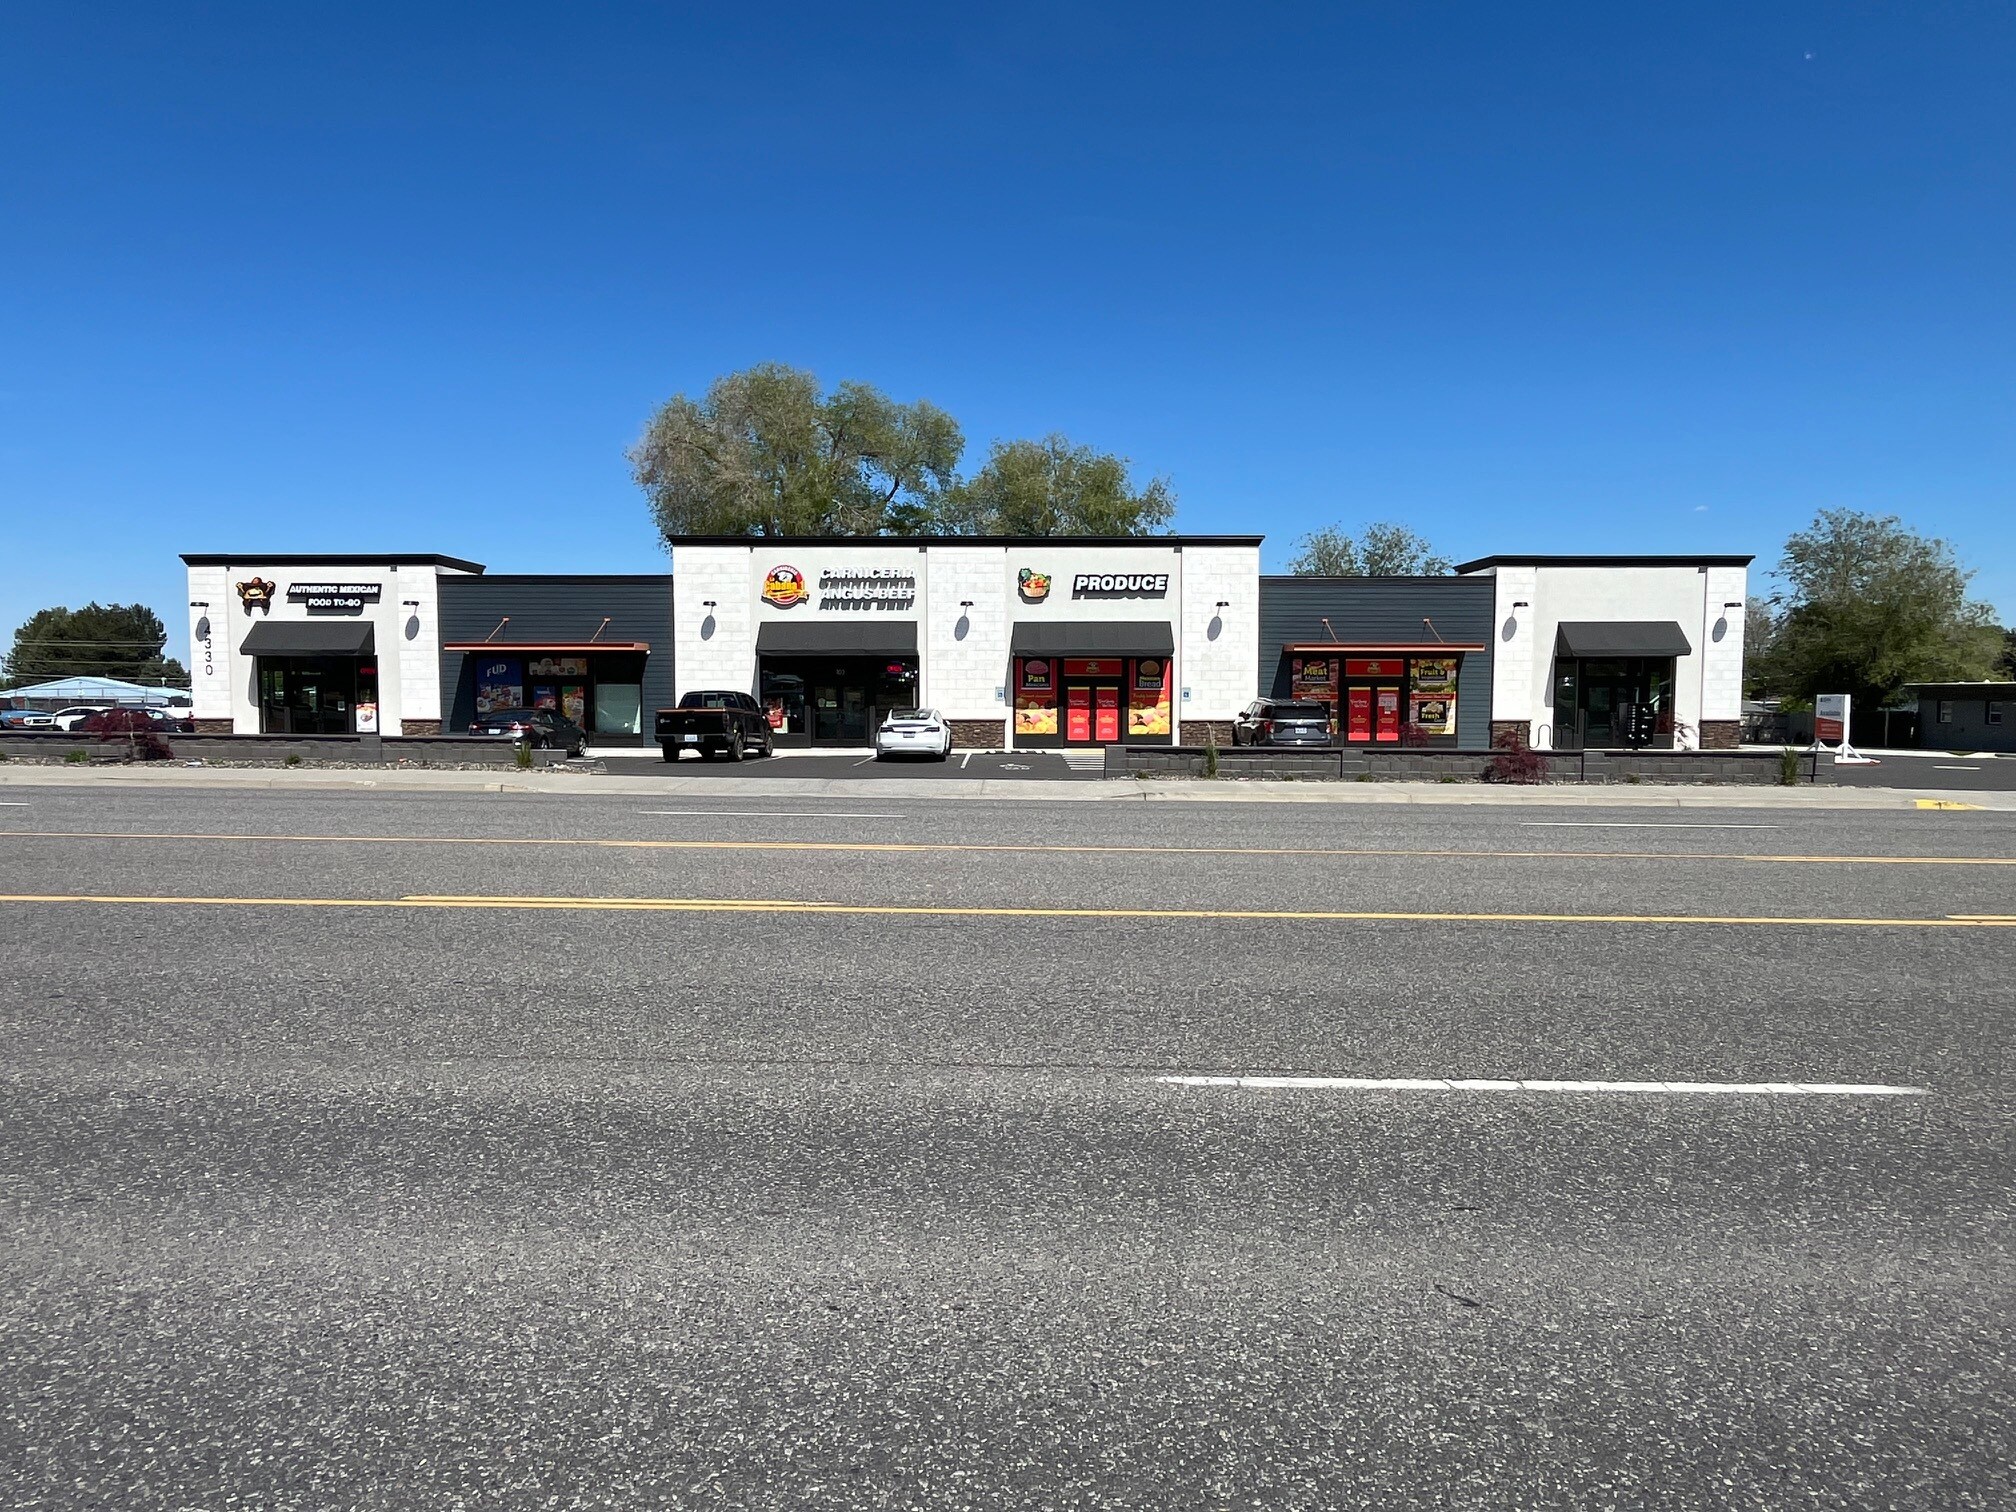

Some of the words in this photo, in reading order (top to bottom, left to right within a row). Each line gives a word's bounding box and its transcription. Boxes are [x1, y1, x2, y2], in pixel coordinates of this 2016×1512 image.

[819, 567, 916, 578] CARNICERIA
[1075, 576, 1167, 590] PRODUCE
[290, 586, 338, 594] AUTHENTIC
[339, 586, 378, 594] MEXICAN
[820, 588, 874, 600] ANGUS
[877, 588, 916, 600] BEEF
[308, 598, 332, 606] FOOD
[333, 598, 361, 606] TO-GO
[204, 625, 213, 676] 4330
[486, 664, 507, 678] FUD
[1303, 667, 1328, 675] Meat
[1027, 674, 1045, 683] Pan
